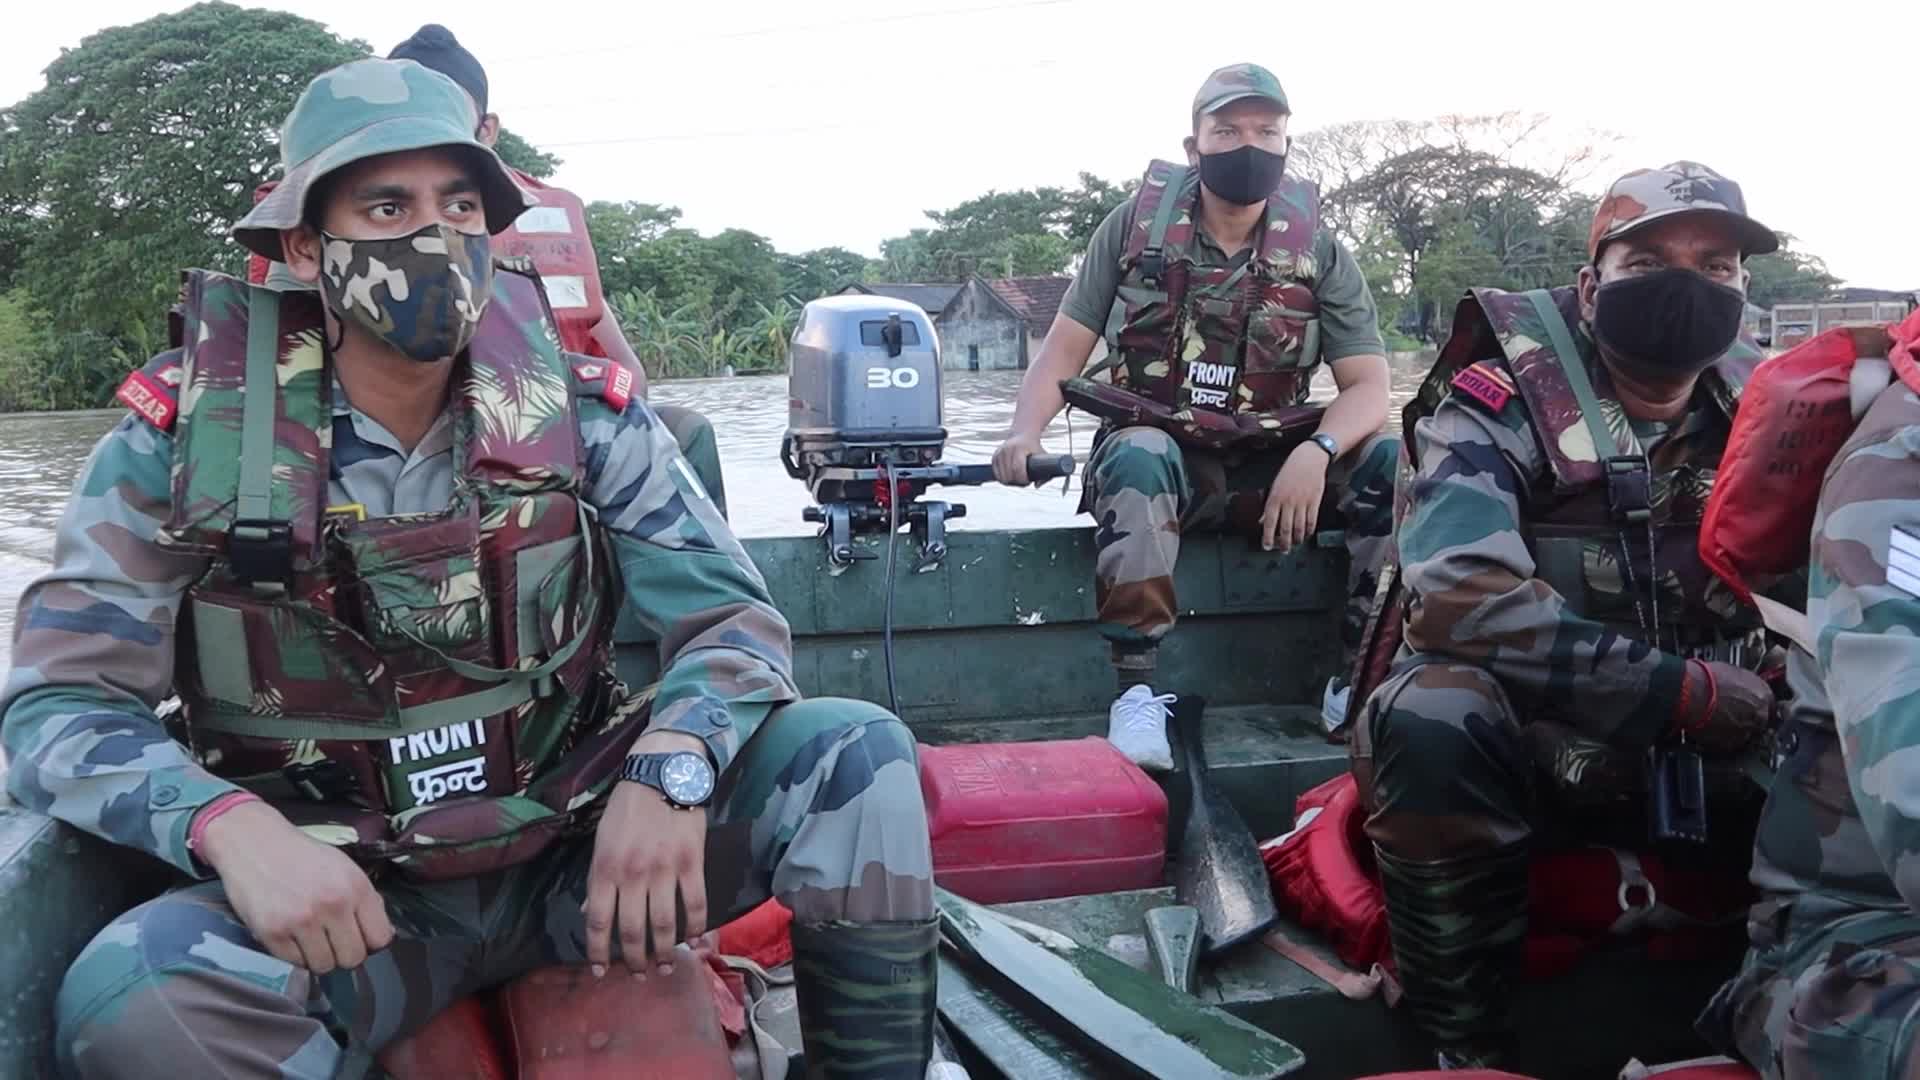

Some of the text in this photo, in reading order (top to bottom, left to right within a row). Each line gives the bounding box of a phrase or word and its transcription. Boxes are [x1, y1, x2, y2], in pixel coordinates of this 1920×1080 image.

[867, 367, 919, 388] 30
[1188, 361, 1236, 387] FRONT
[389, 718, 486, 765] FRONT
